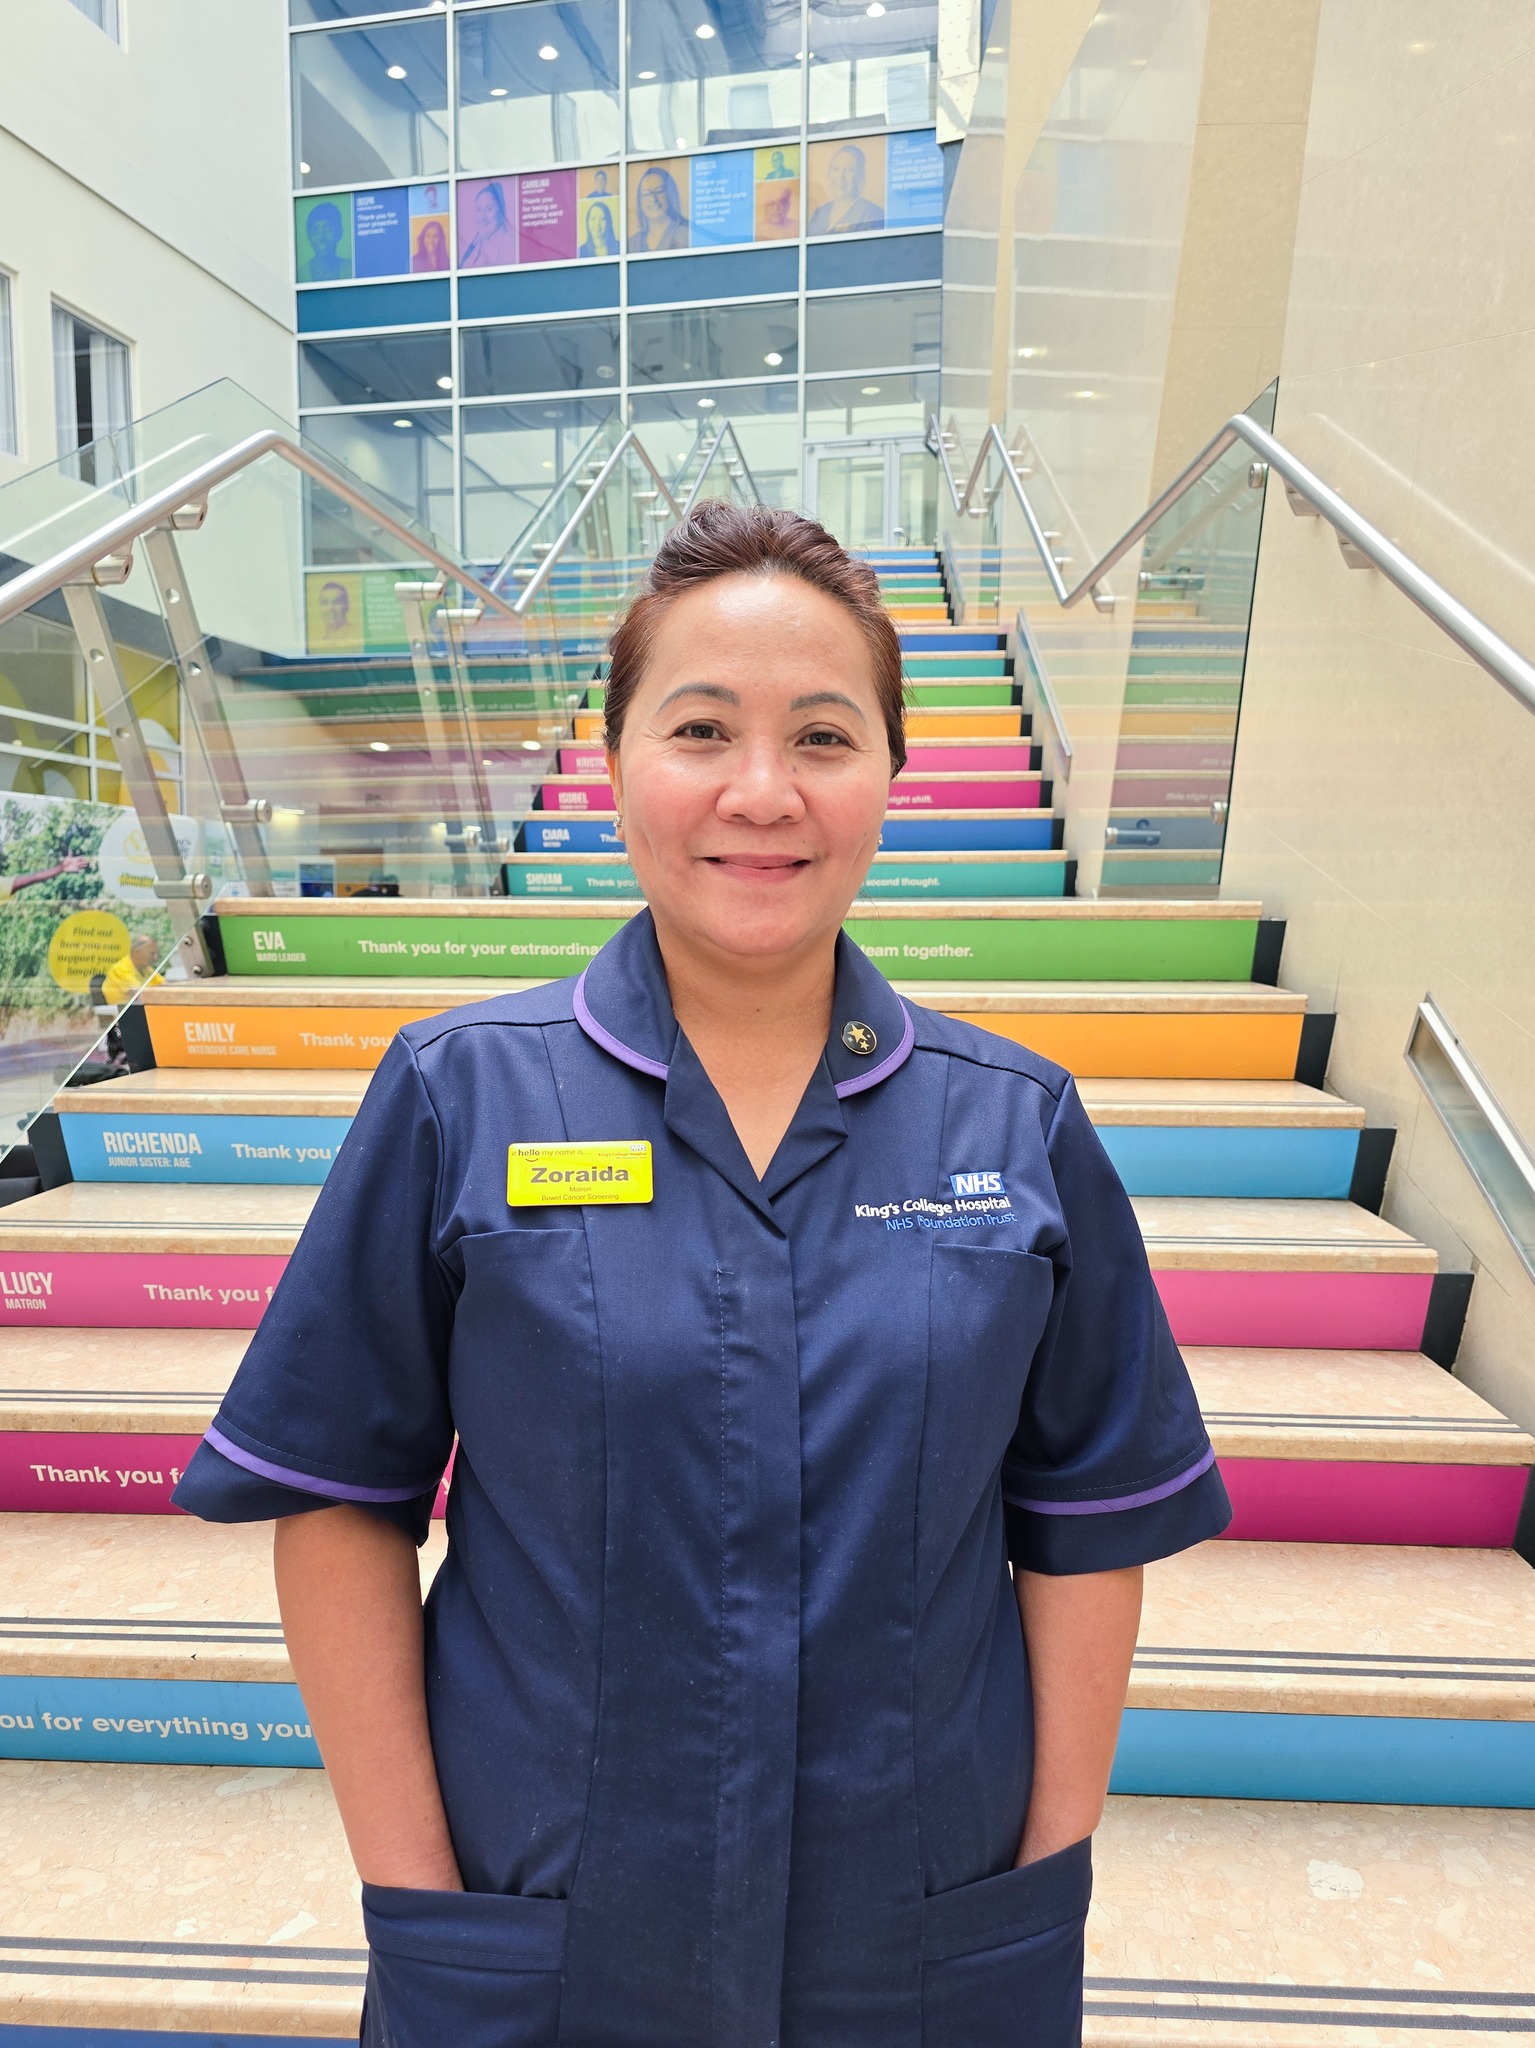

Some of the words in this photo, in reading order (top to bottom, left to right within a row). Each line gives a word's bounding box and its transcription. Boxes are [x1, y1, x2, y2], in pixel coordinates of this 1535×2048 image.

[558, 792, 588, 804] ISOBEL
[525, 873, 563, 885] SHIVAM
[586, 878, 615, 887] Thank
[865, 877, 899, 887] second
[901, 877, 941, 888] thought.
[253, 931, 286, 950] EVA
[358, 940, 408, 955] Thank
[411, 942, 441, 958] you
[444, 941, 467, 955] for
[470, 944, 507, 958] your
[510, 942, 603, 956] extraordina
[861, 944, 899, 957] team
[903, 944, 974, 960] together.
[256, 952, 277, 962] WARD
[279, 952, 307, 962] LEADER
[183, 1021, 235, 1043] EMILY
[299, 1032, 355, 1047] Thank
[358, 1034, 391, 1050] you
[187, 1045, 227, 1055] INTENSIVE
[229, 1046, 249, 1056] CARE
[251, 1046, 277, 1056] NURSE
[102, 1131, 202, 1154] RICHENDA
[231, 1143, 292, 1159] Thank
[295, 1147, 332, 1163] you
[108, 1156, 138, 1167] JUNIOR
[140, 1156, 171, 1168] SISTER:
[530, 1166, 629, 1183] Zoraida
[955, 1174, 1001, 1194] NHS
[587, 1193, 619, 1201] Screening
[855, 1203, 900, 1218] King's
[903, 1198, 953, 1216] College
[955, 1196, 1011, 1212] Hospital
[885, 1217, 913, 1231] NHS
[917, 1214, 984, 1230] Foundation
[986, 1212, 1018, 1225] Trust
[0, 1271, 53, 1295] LUCY
[143, 1284, 214, 1301] Thank
[221, 1288, 260, 1305] you
[5, 1298, 47, 1310] MATRON
[29, 1464, 110, 1484] Thank
[115, 1469, 163, 1488] you
[0, 1714, 35, 1729] ou
[41, 1712, 83, 1732] for
[91, 1716, 249, 1741] everything
